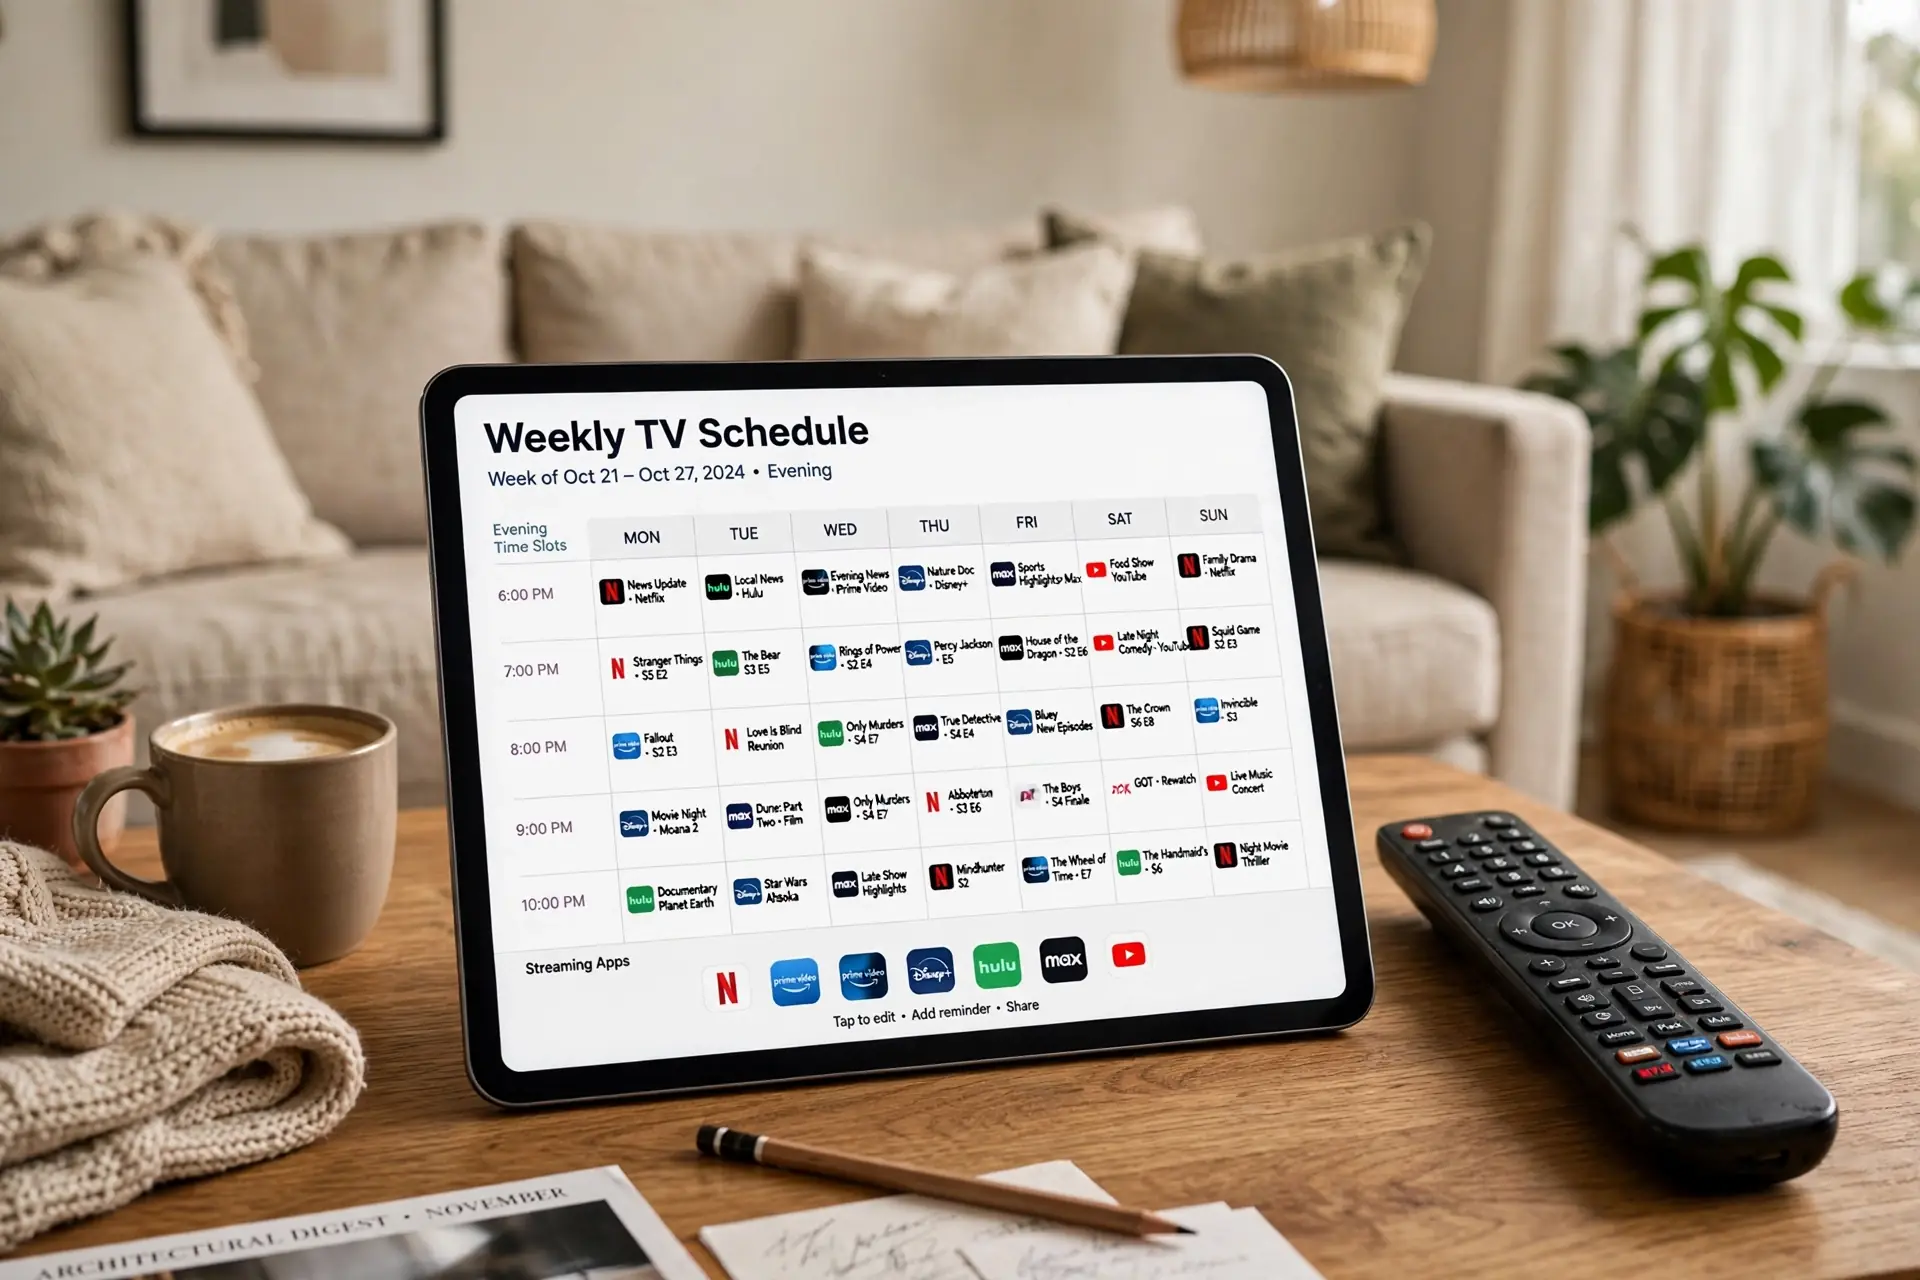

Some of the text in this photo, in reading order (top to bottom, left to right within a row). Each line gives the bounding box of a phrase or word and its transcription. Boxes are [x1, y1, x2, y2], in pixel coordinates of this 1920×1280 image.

[483, 416, 869, 459] Weekly TV Schedule
[488, 462, 833, 487] Week of Oct 21 Oct 27, 2024 Evening
[1108, 512, 1133, 526] SAT
[1200, 508, 1228, 522] SUN
[920, 519, 949, 534] THU
[1017, 515, 1038, 530] FRI
[493, 522, 547, 538] Evening
[730, 526, 758, 541] TUE
[824, 522, 857, 537] WED
[624, 530, 660, 545] MON
[494, 539, 567, 554] Time Slots
[1132, 558, 1154, 568] Show
[1230, 554, 1256, 563] Drama
[927, 566, 974, 576] Nature Doc
[1018, 562, 1045, 573] Sports
[735, 574, 783, 585] Local News
[831, 570, 889, 583] Evening News
[1112, 571, 1146, 582] YouTube
[628, 578, 686, 590] News Update
[836, 583, 888, 594] Prime Video
[498, 588, 553, 601] 6:00 PM
[1118, 630, 1159, 642] Late Night
[1212, 626, 1260, 640] Squid Game
[934, 639, 993, 652] Percy Jackson
[1026, 634, 1078, 646] House of the
[1215, 639, 1237, 649] S2 E3
[742, 650, 780, 661] The Bear
[839, 644, 901, 657] Rings of Power
[1027, 647, 1088, 661] Dragon S2 E6
[633, 654, 703, 668] Stranger Things
[847, 659, 872, 670] S2 E4
[943, 654, 954, 664] E5
[504, 664, 559, 677] 7:00 PM
[642, 670, 668, 680] S5 E2
[744, 664, 770, 675] S3 E5
[1126, 703, 1170, 714] The Crown
[941, 714, 1001, 725] True Detective
[1035, 710, 1058, 721] Bluey
[1227, 712, 1237, 722] S3
[847, 719, 904, 733] Only Murders
[1037, 721, 1093, 733] New Episodes
[1131, 717, 1154, 727] S6 E8
[747, 725, 801, 738] Love Blind
[964, 729, 974, 738] E4
[644, 733, 673, 743] Fallout
[868, 734, 878, 744] E7
[511, 741, 567, 756] 8:00 PM
[653, 746, 677, 757] S2 E3
[749, 740, 784, 751] Reunion
[1134, 774, 1196, 787] GOT Rewatch
[1231, 769, 1273, 781] Live Music
[1043, 783, 1081, 794] The Boys
[1232, 784, 1264, 794] Concert
[756, 802, 803, 813] Dune: Part
[854, 796, 873, 808] Only
[971, 802, 981, 812] E6
[651, 808, 706, 821] Movie Night
[877, 810, 887, 819] E7
[516, 821, 572, 836] 9:00 PM
[660, 823, 699, 835] Moana 2
[757, 818, 775, 828] Two
[1240, 841, 1288, 856] Night Movie
[1051, 853, 1106, 867] The Wheel of
[1143, 850, 1158, 861] The
[1152, 863, 1163, 874] S6
[862, 870, 907, 882] Late Show
[1052, 869, 1091, 882] Time E7
[764, 877, 807, 889] Star Wars
[958, 878, 969, 888] S2
[658, 884, 717, 897] Documentary
[522, 895, 585, 911] 10:00 PM
[659, 897, 714, 911] Planet Earth
[1552, 920, 1579, 930] OK
[526, 956, 630, 974] Streaming Apps
[978, 959, 1016, 974] hulu
[1045, 953, 1082, 968] max
[774, 976, 798, 987] prime
[842, 970, 863, 981] prime
[833, 1000, 1039, 1029] Tap to edit Add reminder Share
[35, 1186, 567, 1280] ARCHITECTURAL DIGEST NOVEMBER
